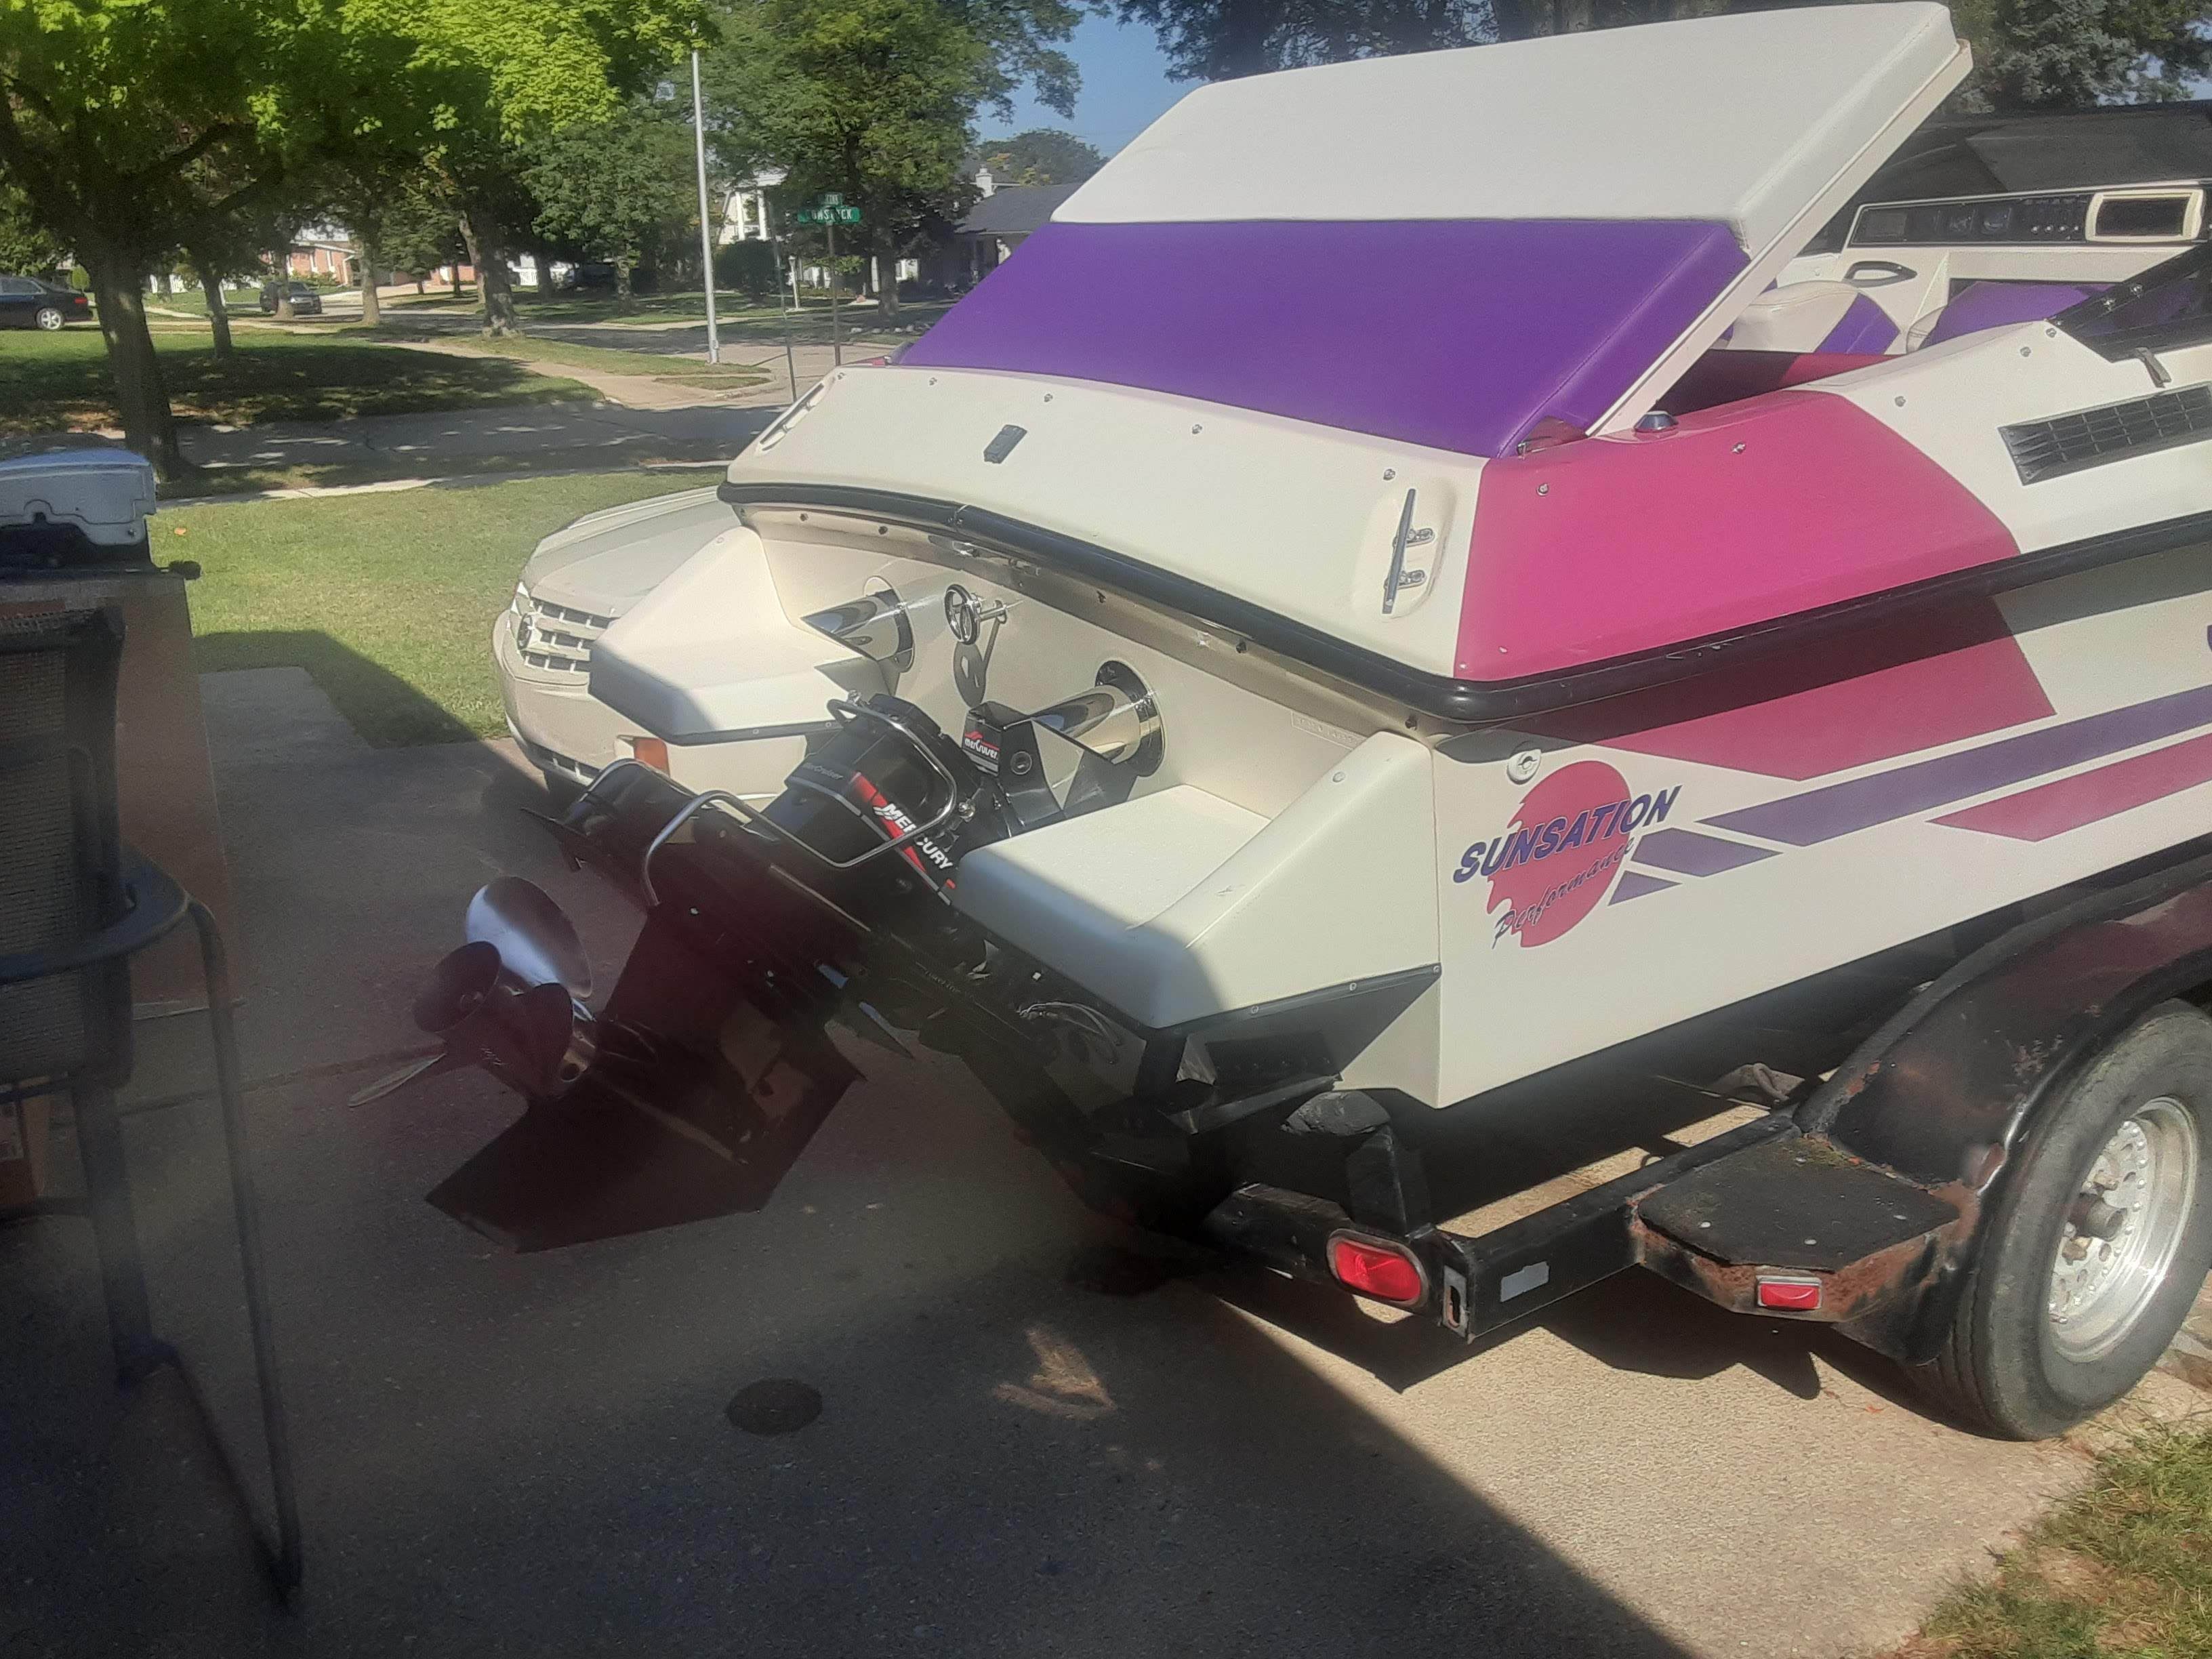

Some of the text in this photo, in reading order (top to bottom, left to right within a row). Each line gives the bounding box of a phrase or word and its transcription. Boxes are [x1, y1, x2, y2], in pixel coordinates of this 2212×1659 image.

[806, 208, 852, 220] OMSTCK
[1452, 784, 1683, 884] SUNSATION
[1491, 836, 1635, 949] Performance
